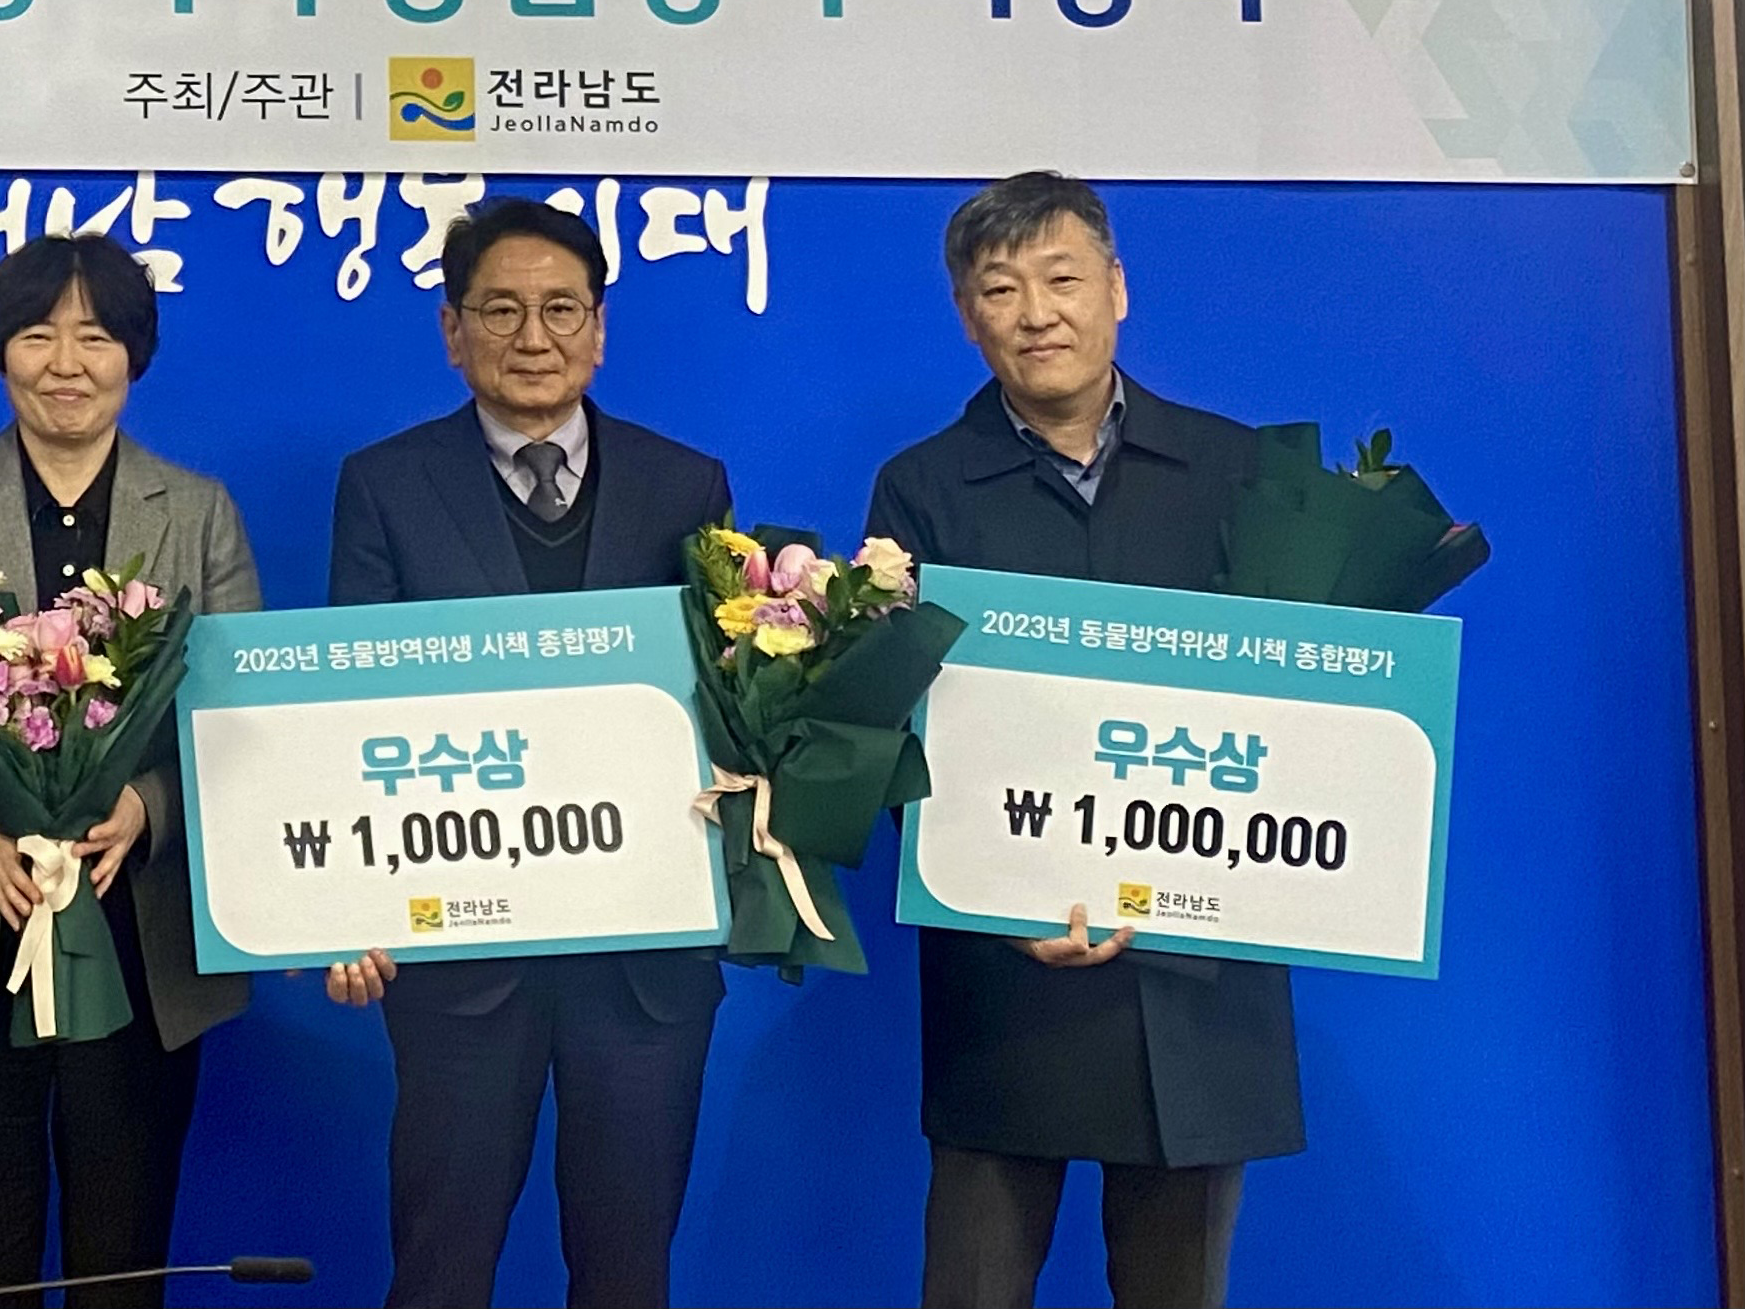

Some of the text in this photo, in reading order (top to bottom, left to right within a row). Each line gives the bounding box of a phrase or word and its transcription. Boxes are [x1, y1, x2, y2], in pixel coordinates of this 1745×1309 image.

[123, 70, 334, 121] 주최/주관
[488, 69, 661, 108] 전라남도
[490, 115, 659, 133] JeollaNamdo
[233, 624, 636, 674] 2023년 동물방역위생 시책 종합평가
[980, 609, 1396, 679] 2023년 동물방역위생 시책 종합평가
[361, 729, 529, 797] 우수상
[1094, 719, 1268, 794] 우수상
[350, 800, 624, 876] 1,000,000
[1073, 793, 1348, 872] 1,000,000
[446, 898, 512, 918] 전라남도
[1156, 892, 1221, 912] 전라남도
